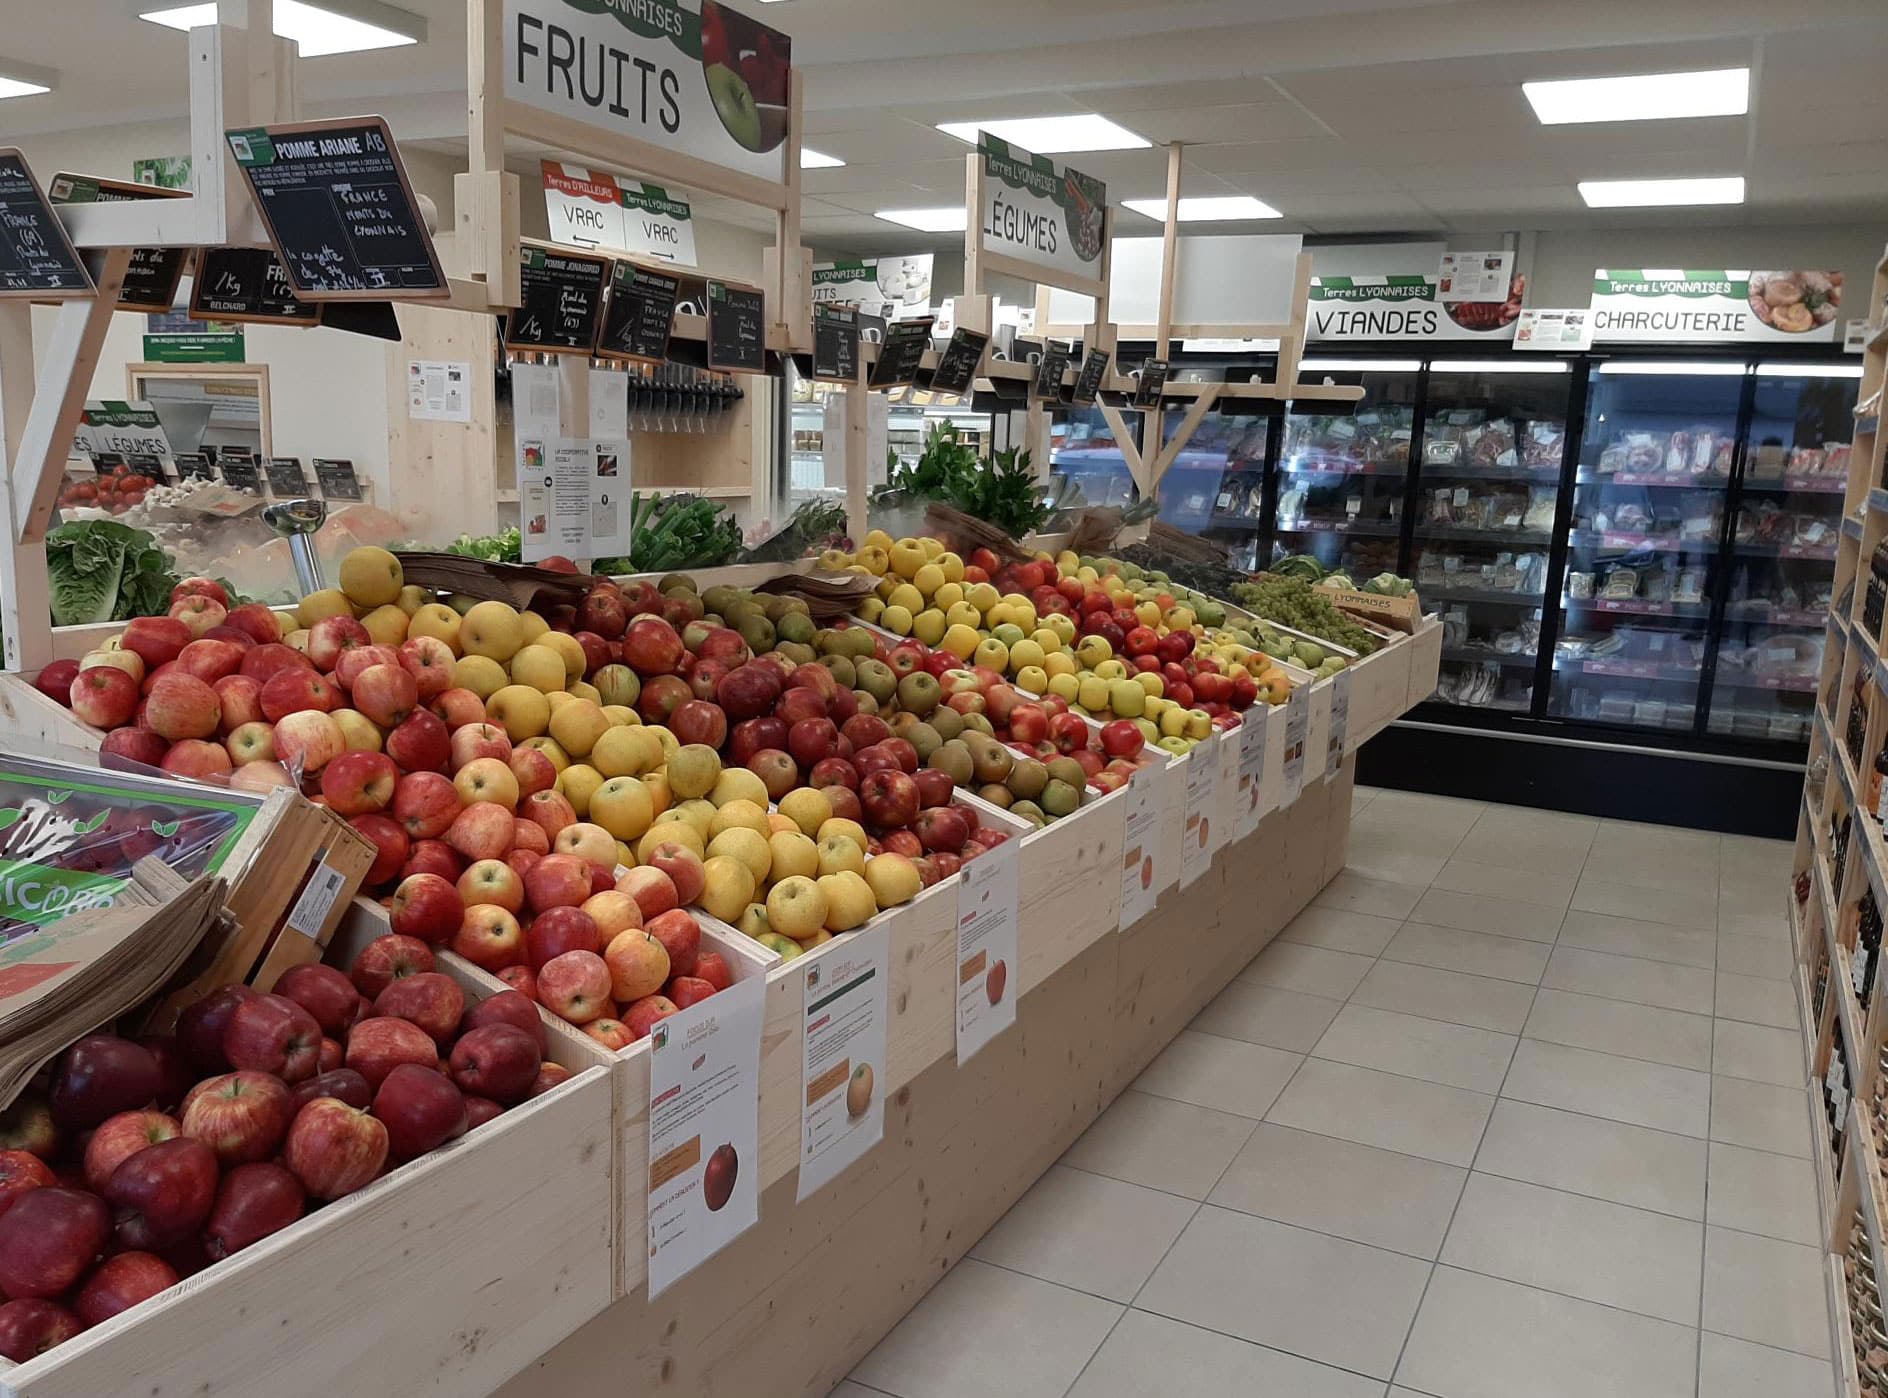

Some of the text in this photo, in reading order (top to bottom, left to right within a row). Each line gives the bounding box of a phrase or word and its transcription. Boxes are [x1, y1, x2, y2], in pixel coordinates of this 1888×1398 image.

[517, 13, 681, 133] FRUITS
[275, 131, 386, 160] POMME ARIANE AB
[547, 174, 572, 189] Terres
[988, 153, 1057, 194] Terres LYONNAISES
[341, 189, 387, 204] FRANCE
[563, 204, 605, 230] VRAC
[984, 192, 1057, 254] ÉGUMES
[642, 220, 679, 244] VRAC
[813, 268, 866, 281] LYONNAISES
[1322, 286, 1429, 298] Terres LYONNAISES
[1610, 281, 1733, 294] Terres LYONNAISES
[1315, 310, 1438, 335] VIANDES
[1594, 311, 1747, 332] CHARCUTERIE
[105, 432, 166, 455] LÉGUMES
[1335, 593, 1391, 609] LYONNAISES
